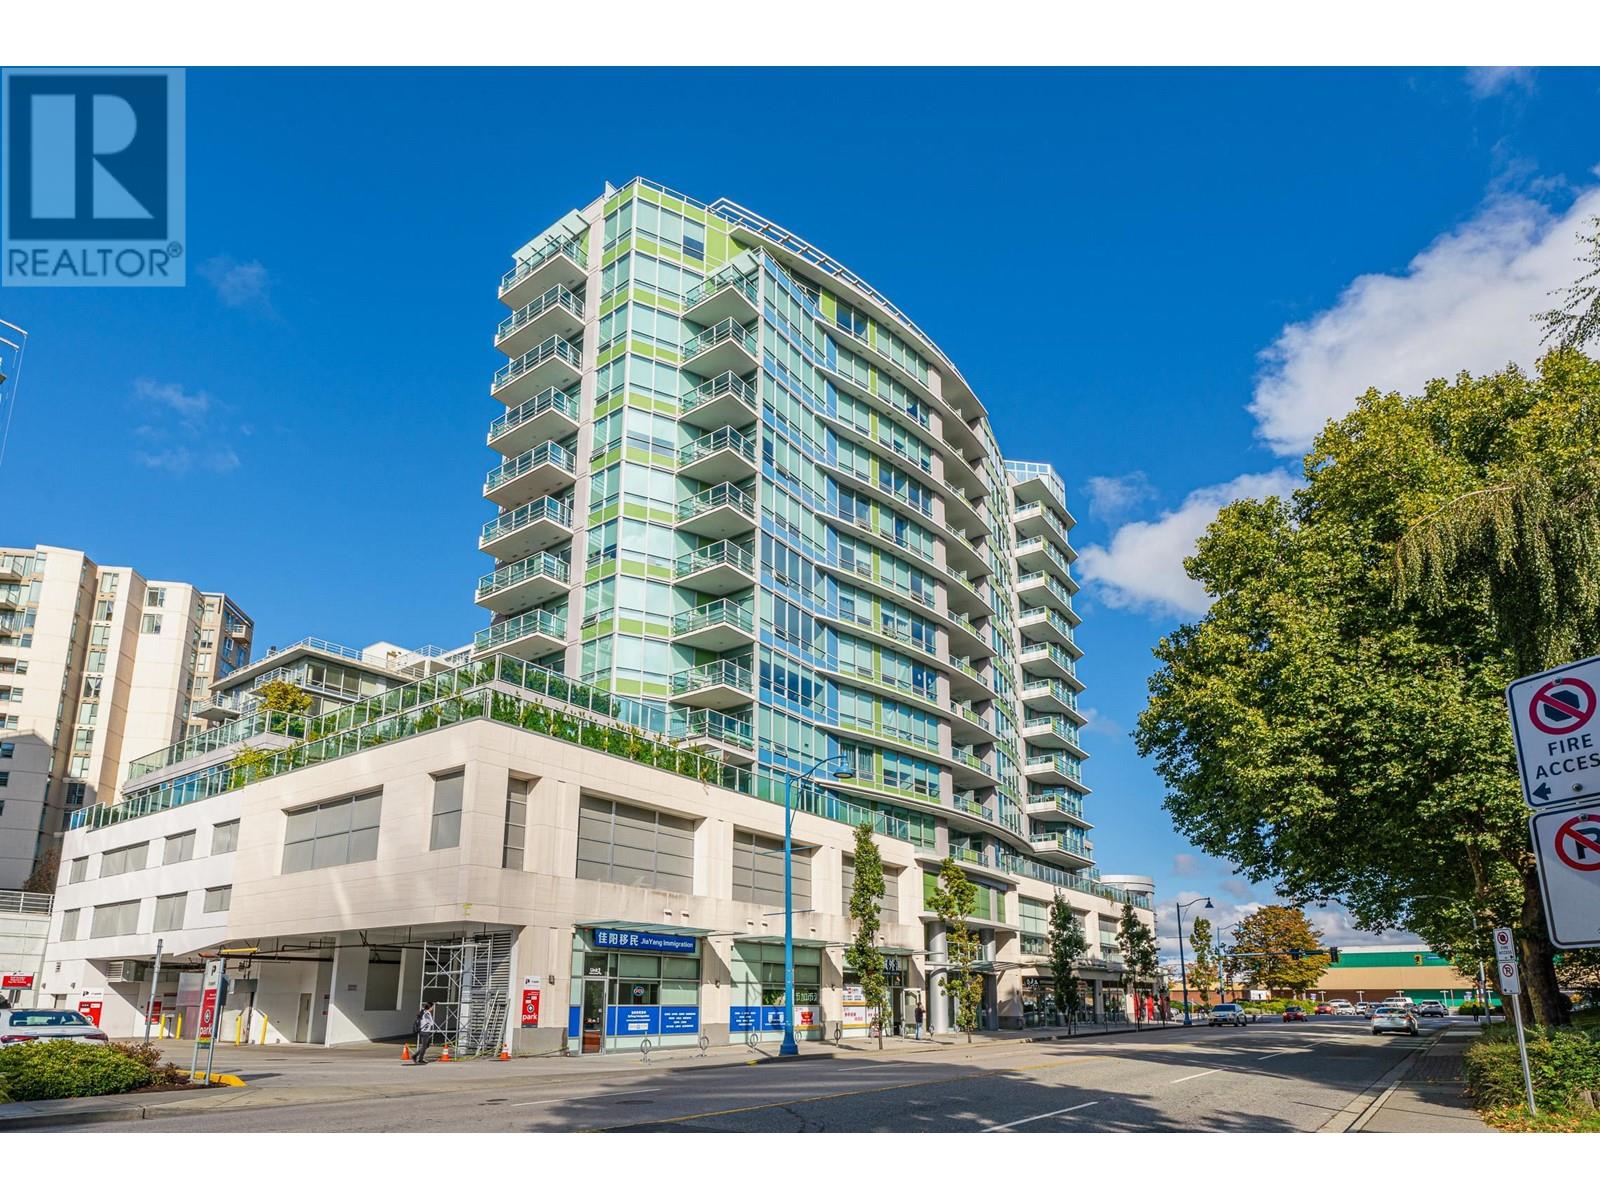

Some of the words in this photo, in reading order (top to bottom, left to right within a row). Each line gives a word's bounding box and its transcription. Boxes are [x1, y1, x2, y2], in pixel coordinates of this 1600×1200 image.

[1548, 733, 1593, 756] FIRE
[641, 938, 663, 947] JiaYang
[663, 940, 693, 948] Immigration
[522, 1013, 538, 1022] park
[200, 1023, 213, 1035] park
